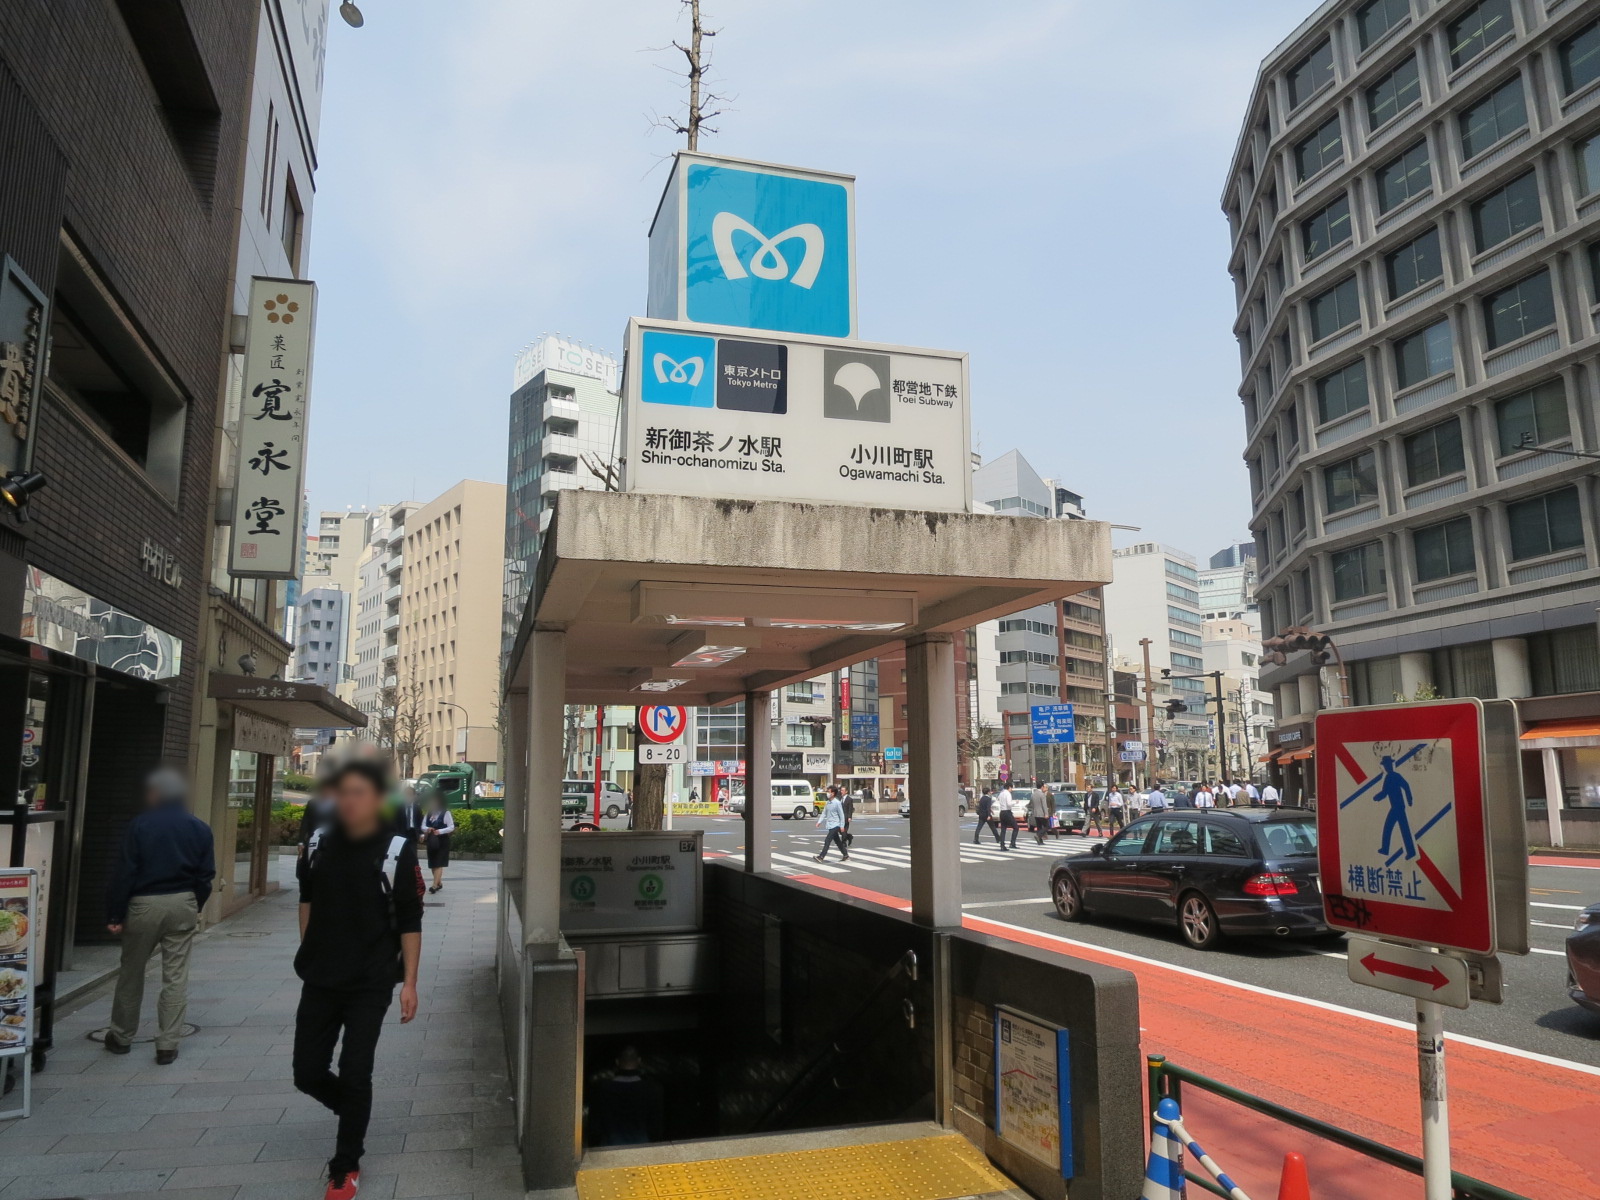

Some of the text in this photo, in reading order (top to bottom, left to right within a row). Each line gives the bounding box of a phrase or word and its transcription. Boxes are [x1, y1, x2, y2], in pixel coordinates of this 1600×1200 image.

[269, 334, 287, 370] 菓匠
[558, 347, 609, 375] TOSEI
[724, 364, 782, 380] 東京メトロ
[727, 377, 778, 390] Tokyo Metro
[892, 379, 958, 399] 都営地下鉄
[897, 394, 954, 409] Toei Subway
[645, 426, 782, 459] 新御茶ノ水駅
[245, 379, 293, 535] 寛永堂
[641, 450, 786, 473] Shin-ochanomizu Sta.
[850, 444, 935, 470] 小川町駅
[838, 465, 946, 485] Ogawamachi Sta.
[143, 537, 183, 588] 中村ビル
[681, 841, 695, 852] B7
[561, 855, 671, 866] 御茶ノ水駅 小川町駅
[1348, 864, 1426, 901] 横断禁止
